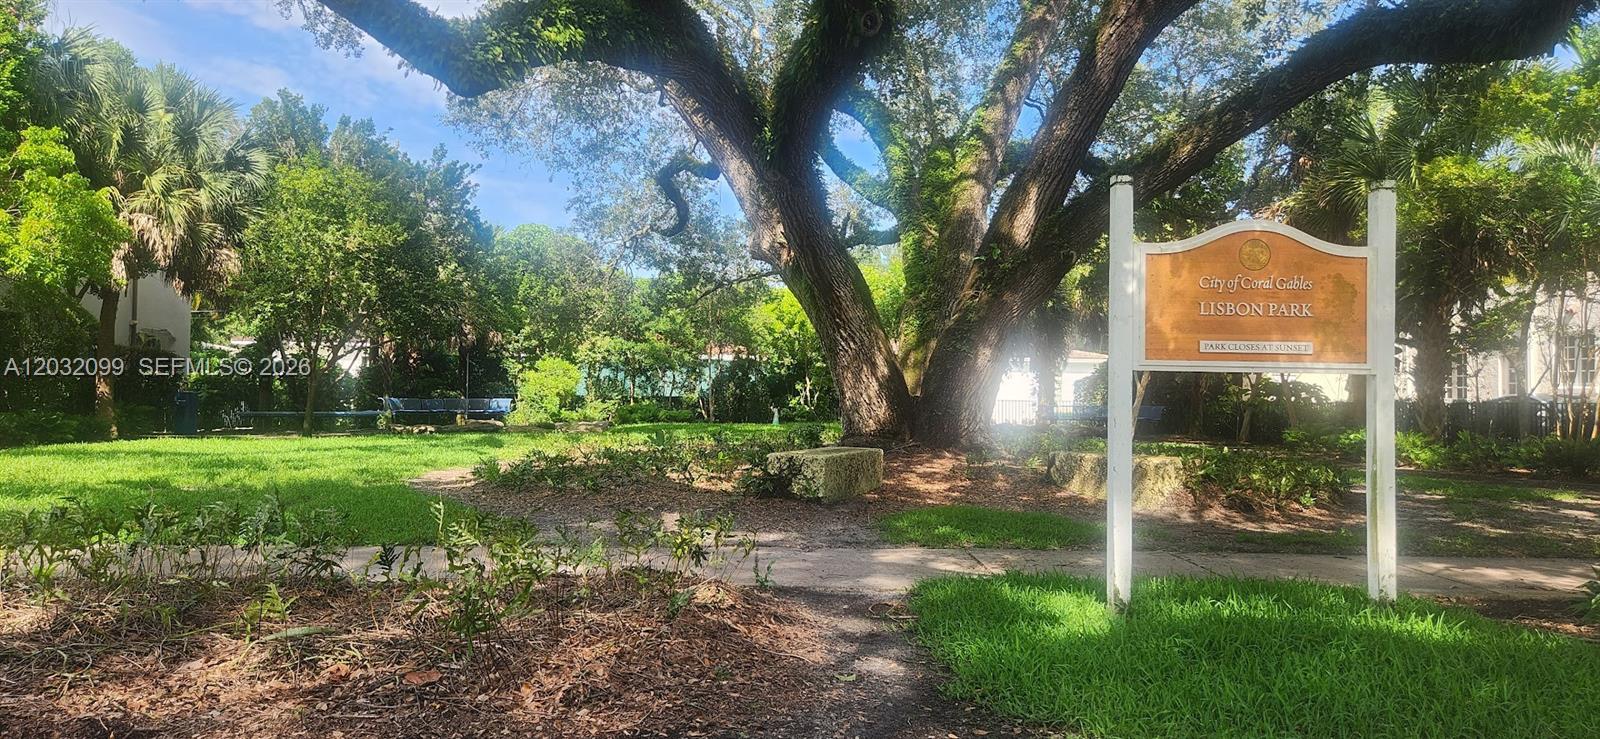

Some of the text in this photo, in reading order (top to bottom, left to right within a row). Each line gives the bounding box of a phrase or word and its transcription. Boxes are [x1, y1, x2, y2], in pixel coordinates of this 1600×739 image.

[1199, 274, 1313, 293] City of Coral Gables
[1199, 302, 1313, 317] LISBON PARK
[1204, 343, 1226, 351] PARK
[1228, 343, 1260, 351] CLOSES
[1275, 344, 1309, 352] SUNSET
